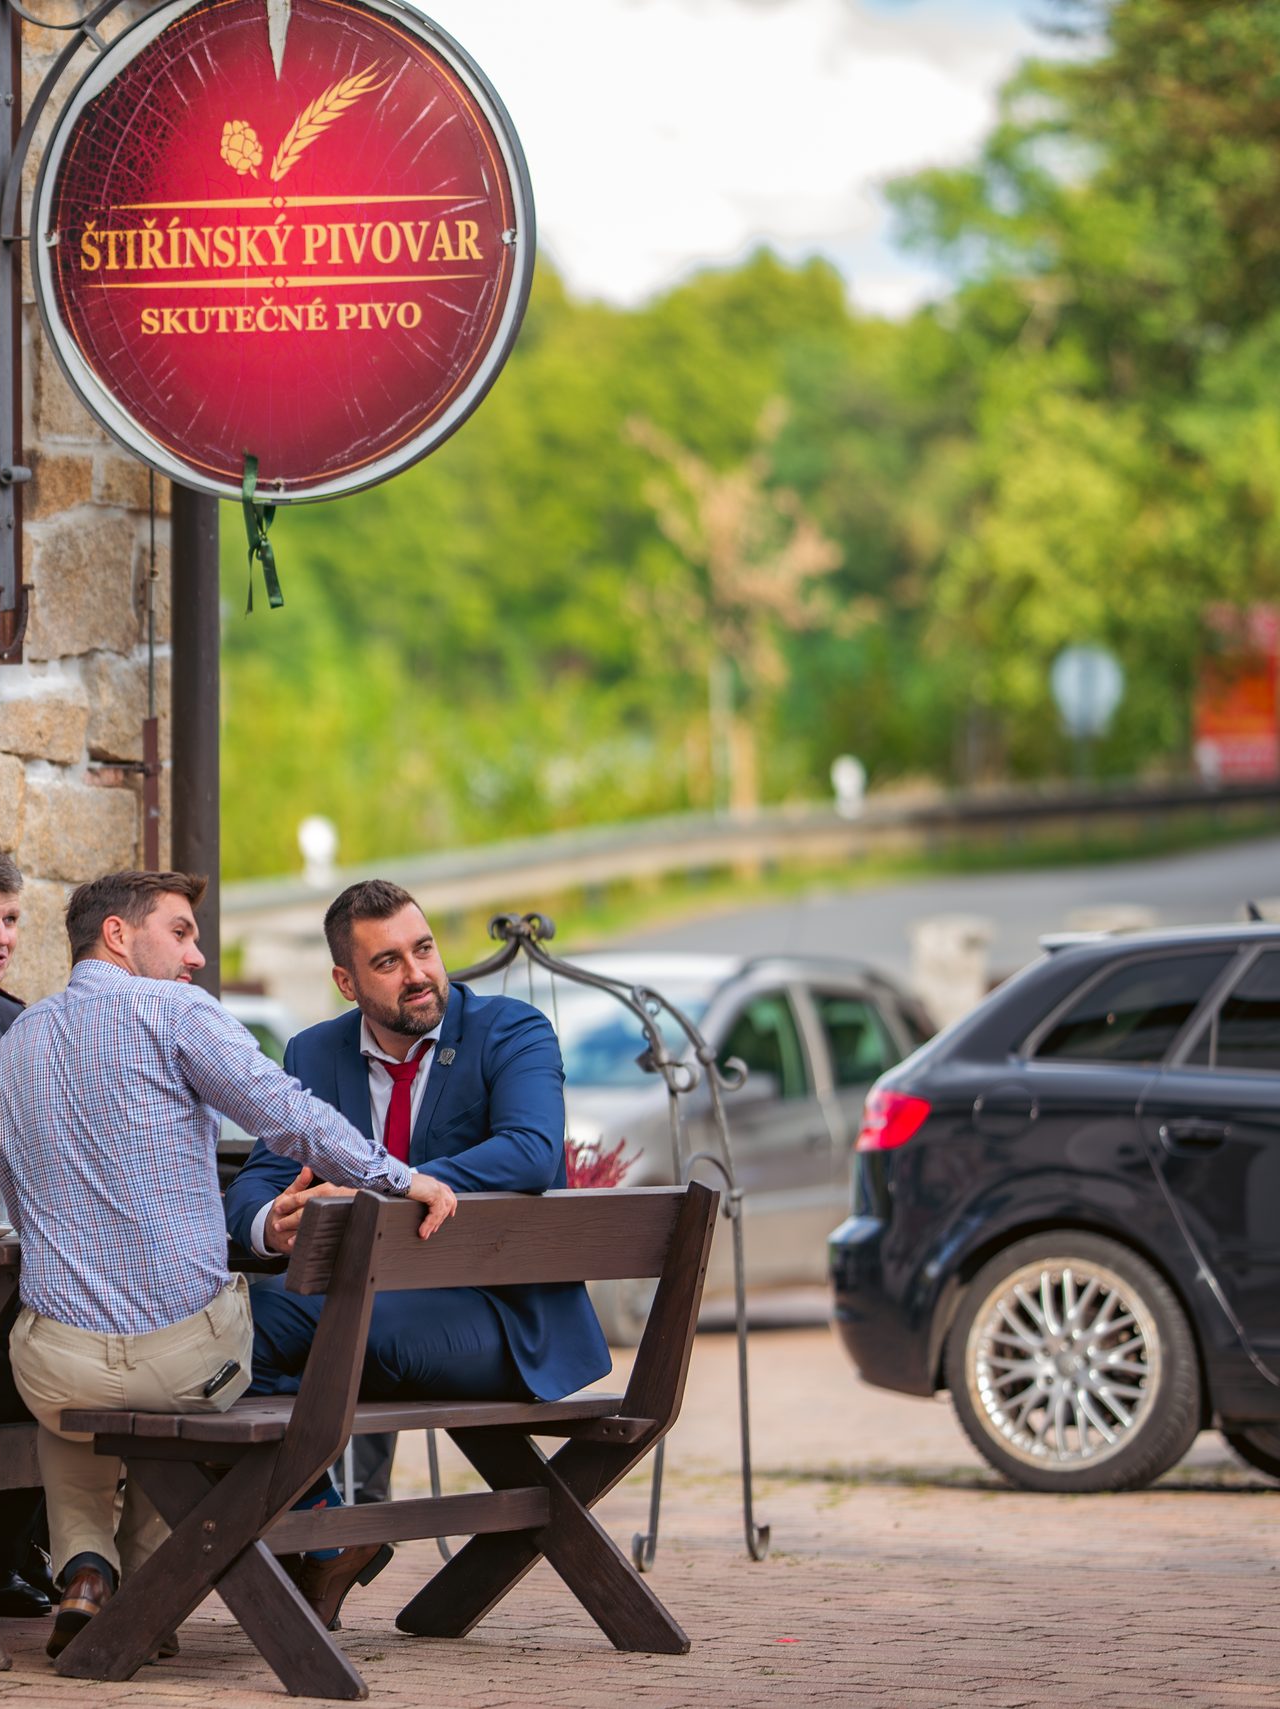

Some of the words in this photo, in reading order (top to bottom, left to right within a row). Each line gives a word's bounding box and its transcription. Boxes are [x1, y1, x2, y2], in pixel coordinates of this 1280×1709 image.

[81, 214, 291, 271] ŠTIŘÍNSKÝ
[303, 220, 483, 265] PIVOVAR
[141, 297, 328, 335] SKUTEČNÉ
[336, 302, 422, 331] PIVO
